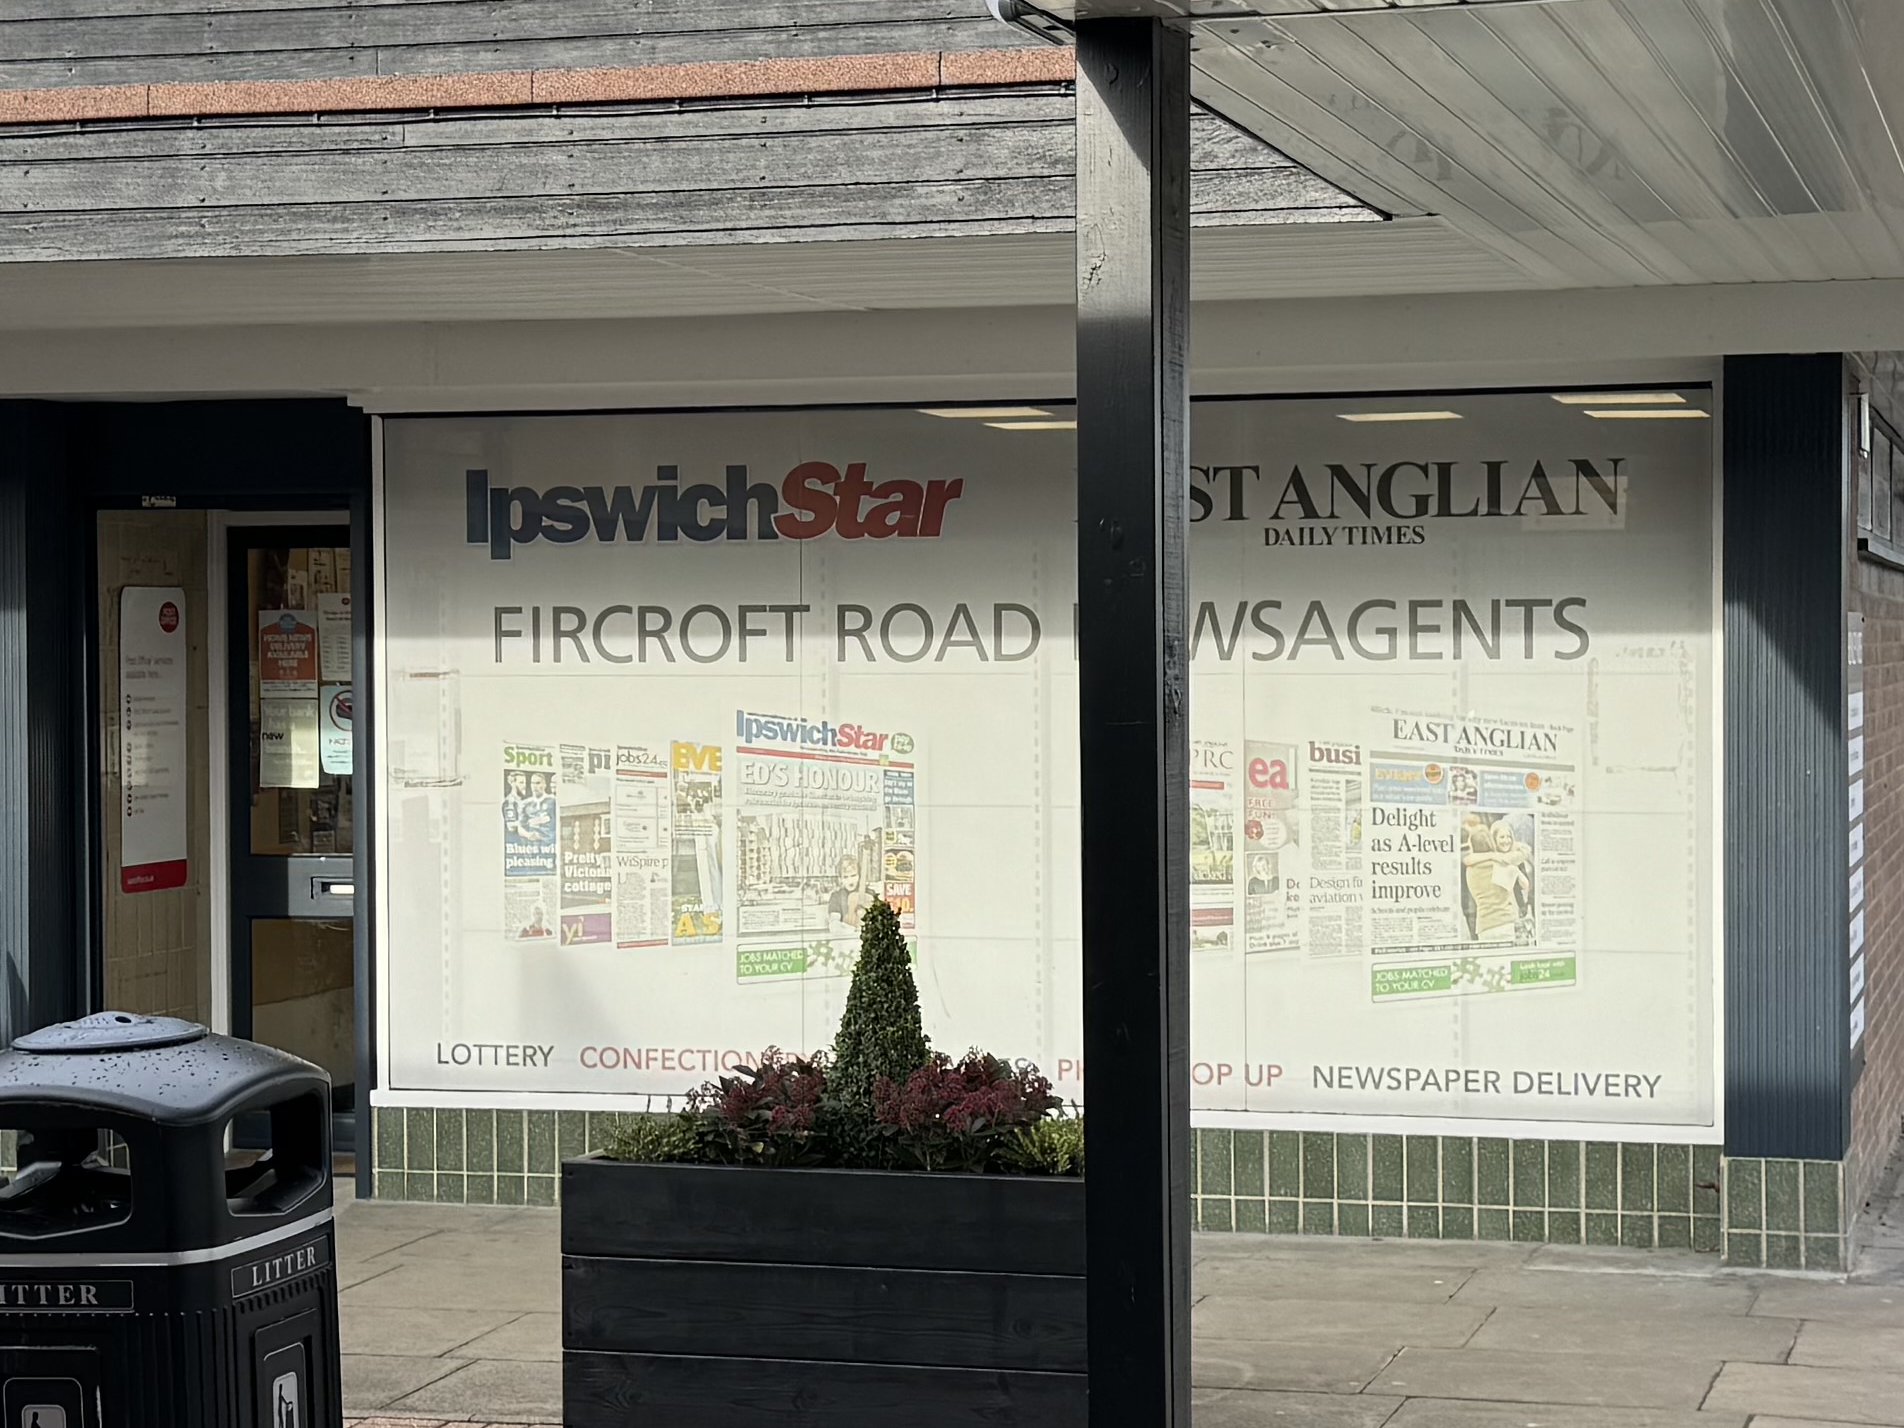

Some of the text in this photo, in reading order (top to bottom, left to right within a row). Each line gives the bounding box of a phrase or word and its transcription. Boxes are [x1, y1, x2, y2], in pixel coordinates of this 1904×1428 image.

[1268, 458, 1627, 521] ANGLIAN
[1264, 525, 1427, 547] DAILY TIMES
[494, 604, 811, 664] FIRCROFT
[836, 602, 1042, 663] ROAD
[261, 731, 285, 741] new
[1393, 718, 1558, 753] EAST ANGLIAN
[503, 746, 553, 768] Sport
[795, 764, 881, 794] HONOUR
[1248, 757, 1290, 790] ea
[1371, 807, 1437, 832] Delight
[1371, 833, 1455, 853] as A-level
[506, 856, 553, 870] pleasing
[1371, 856, 1433, 876] results
[887, 883, 912, 897] SAVE
[1309, 876, 1346, 893] Design
[1371, 880, 1442, 903] improve
[1309, 891, 1358, 905] aviation
[739, 949, 804, 964] JOBS MATCHED
[739, 961, 794, 974] TO YOUR CV
[1375, 968, 1448, 982] JOBS MATCHED
[1375, 980, 1435, 993] TO YOUR CV
[436, 1042, 555, 1068] LOTTERY
[1244, 1063, 1284, 1088] UP
[1312, 1065, 1501, 1094] NEWSPAPER
[1512, 1070, 1663, 1099] DELIVERY
[250, 1246, 318, 1288] LITTER
